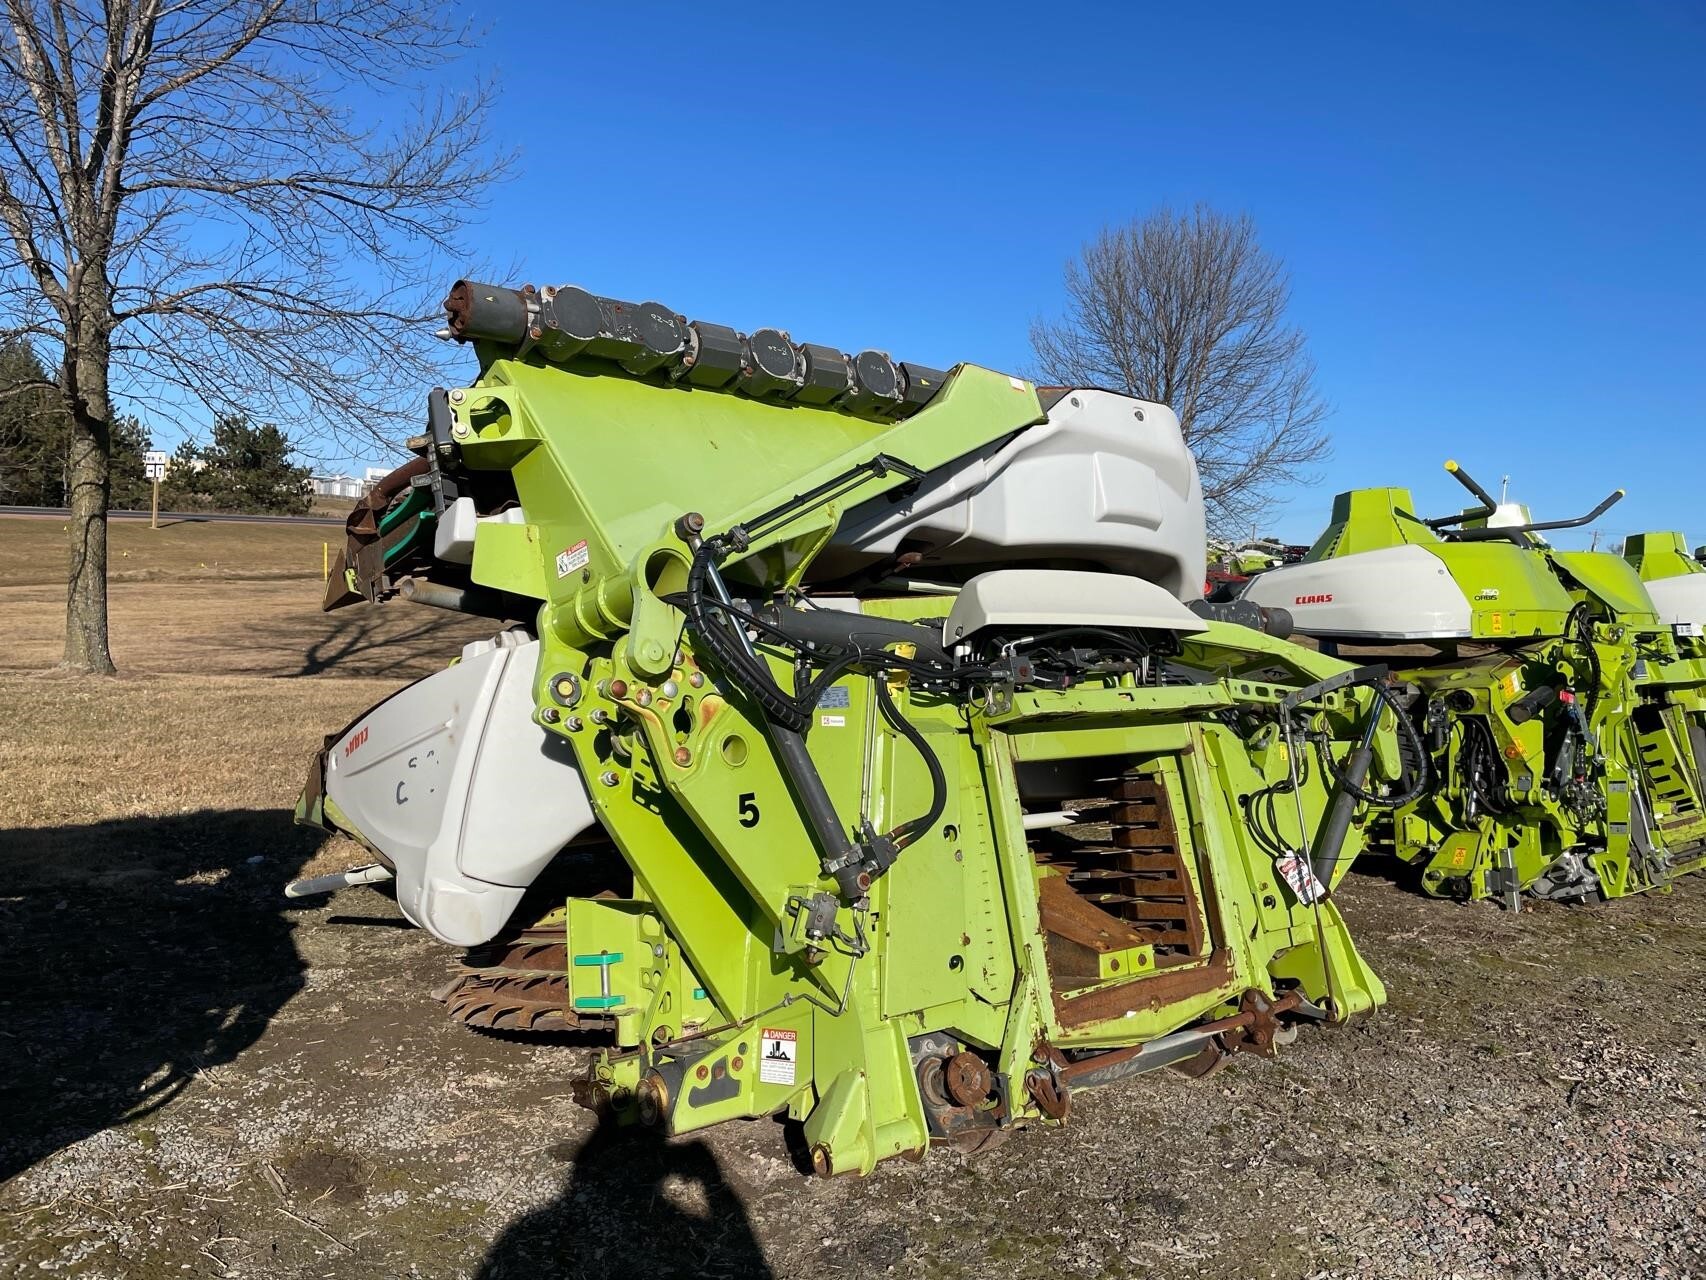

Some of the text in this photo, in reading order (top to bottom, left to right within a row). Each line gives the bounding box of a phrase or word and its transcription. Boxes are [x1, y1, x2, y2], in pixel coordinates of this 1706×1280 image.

[1295, 594, 1332, 604] CLAAS
[738, 791, 760, 829] 5
[770, 1030, 796, 1040] DANGER
